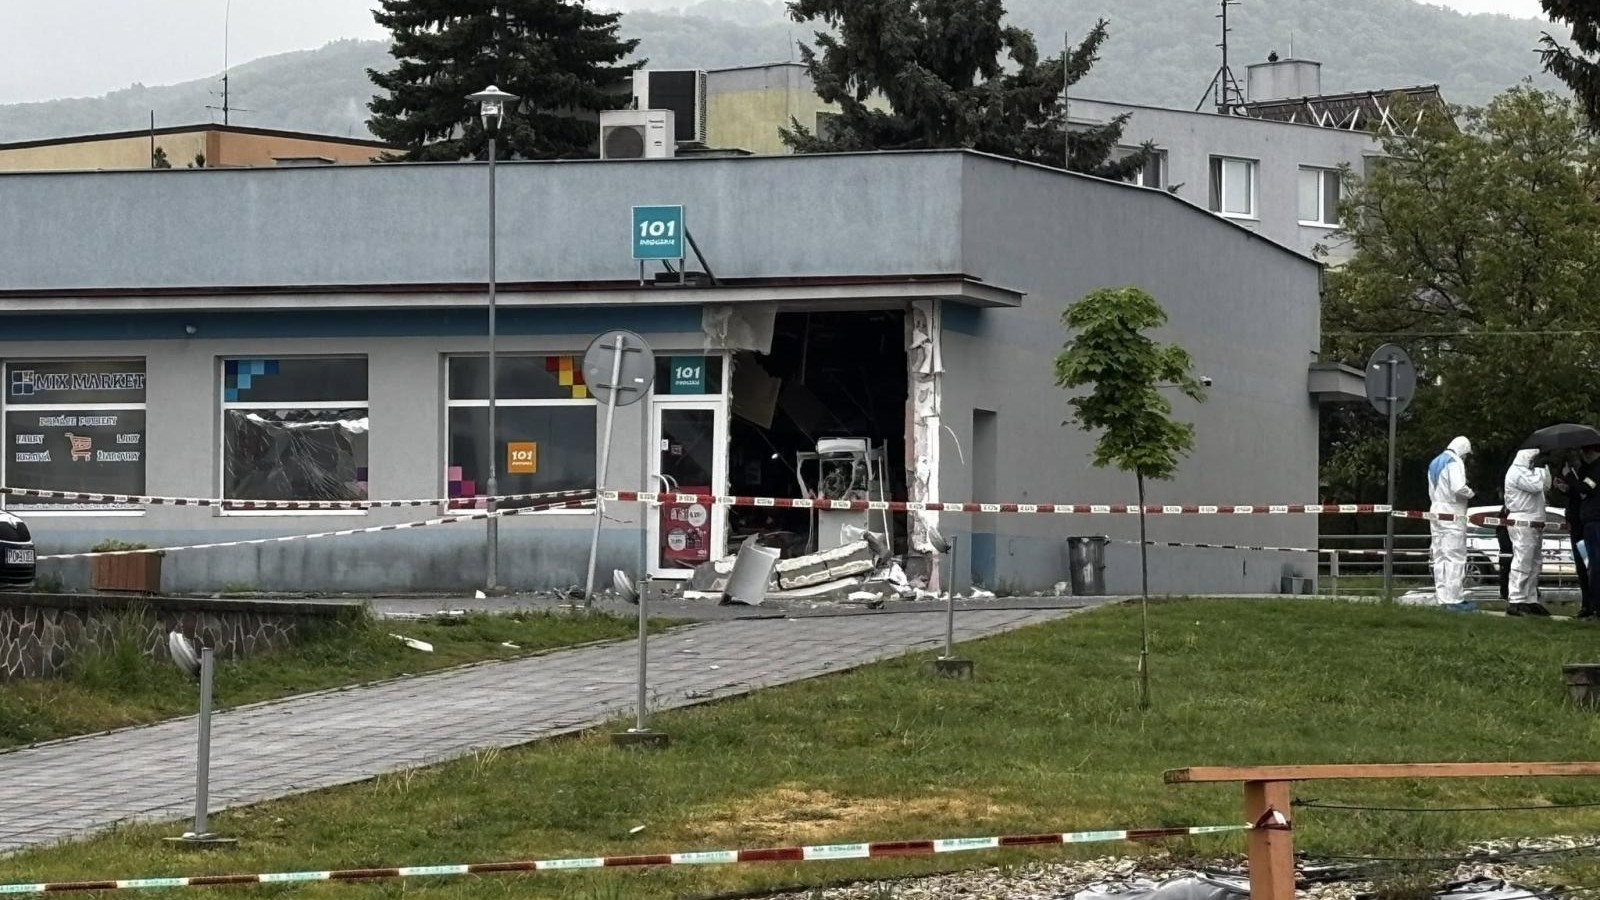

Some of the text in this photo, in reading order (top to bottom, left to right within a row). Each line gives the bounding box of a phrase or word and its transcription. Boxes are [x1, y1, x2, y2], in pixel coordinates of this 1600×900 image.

[640, 220, 675, 237] 101
[675, 366, 700, 379] 101
[34, 372, 145, 390] MIX MARKET
[512, 450, 533, 460] 101
